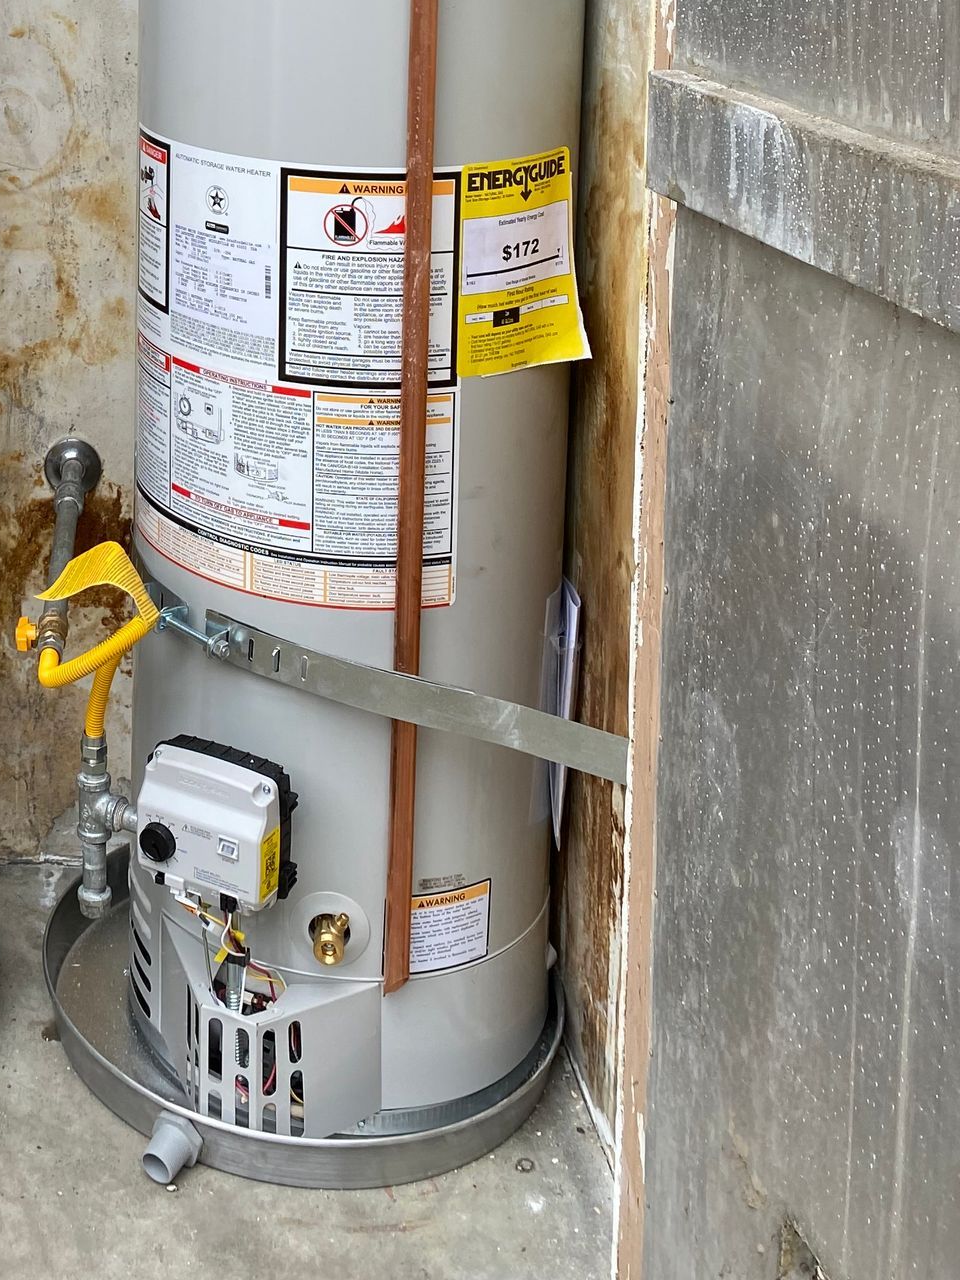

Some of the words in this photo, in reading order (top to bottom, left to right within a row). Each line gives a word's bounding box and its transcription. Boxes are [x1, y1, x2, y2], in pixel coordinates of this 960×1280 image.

[467, 155, 565, 192] ENERGYGUIDE
[353, 186, 404, 195] WARNING
[502, 238, 539, 262] $172
[425, 893, 466, 907] WARNING
